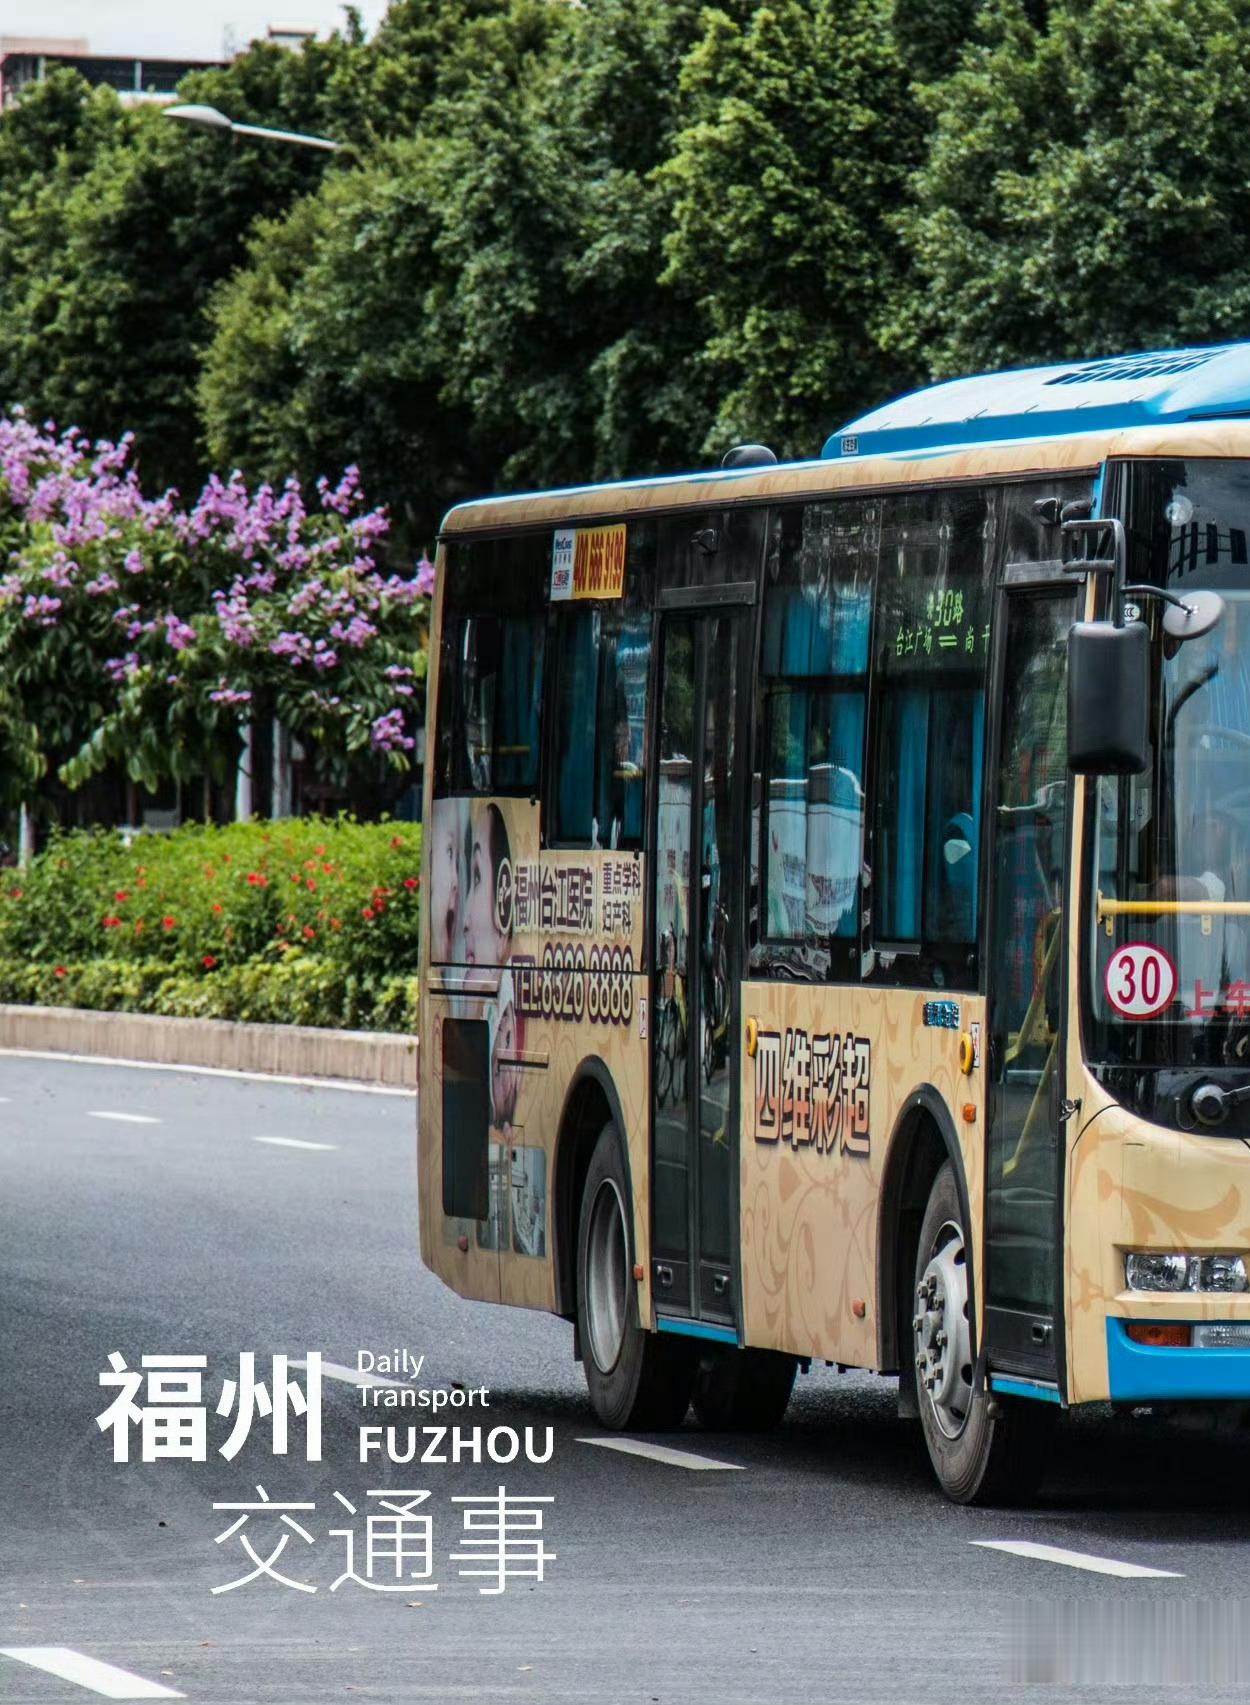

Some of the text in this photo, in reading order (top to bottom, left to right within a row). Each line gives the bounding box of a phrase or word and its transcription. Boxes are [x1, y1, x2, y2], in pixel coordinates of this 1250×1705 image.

[514, 863, 594, 929] 福州台江医院
[602, 861, 641, 898] 重点学科
[602, 899, 632, 936] 妇产科
[588, 944, 634, 1026] 8888
[1117, 955, 1162, 1006] 30
[755, 1027, 871, 1159] 四维彩超
